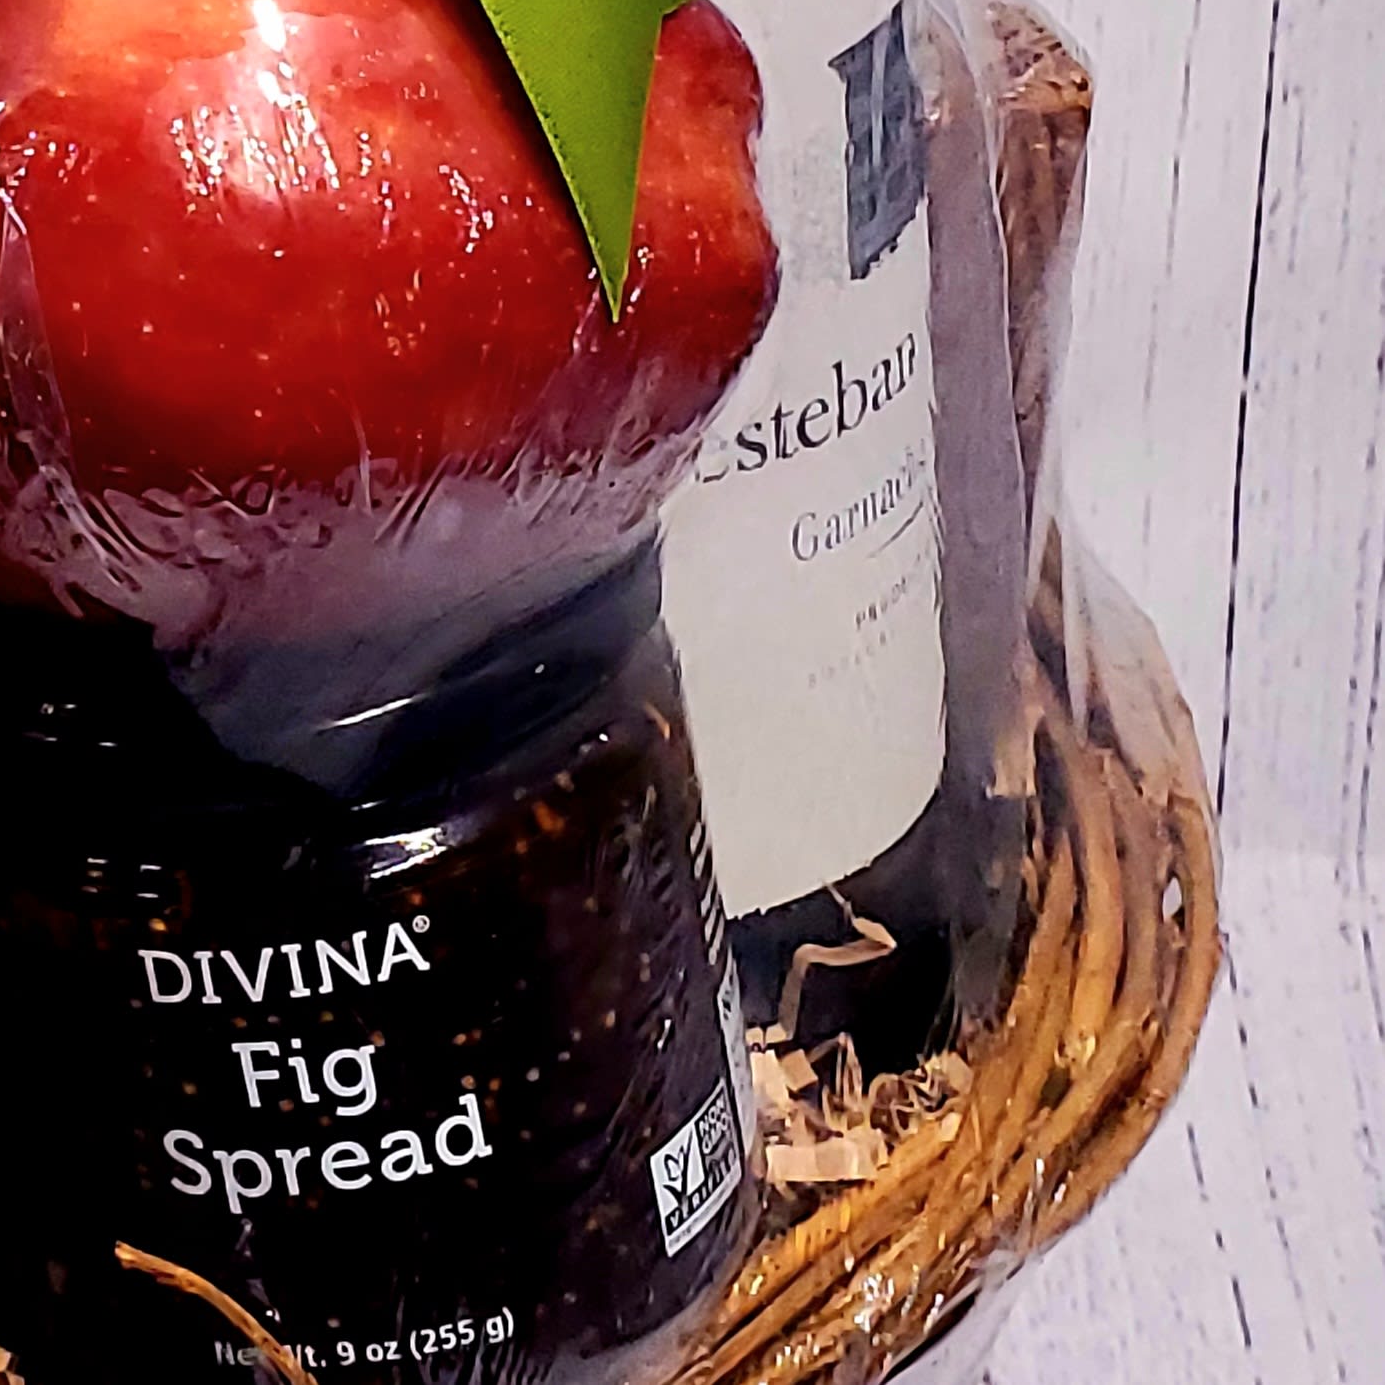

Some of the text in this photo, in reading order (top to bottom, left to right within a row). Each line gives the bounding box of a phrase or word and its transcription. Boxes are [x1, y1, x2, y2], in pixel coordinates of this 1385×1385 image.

[230, 1037, 377, 1117] Fig
[161, 1092, 494, 1215] Spread
[335, 1340, 357, 1366] 9
[365, 1340, 403, 1363] oz
[409, 1318, 476, 1362] (255
[485, 1305, 515, 1344] g)
